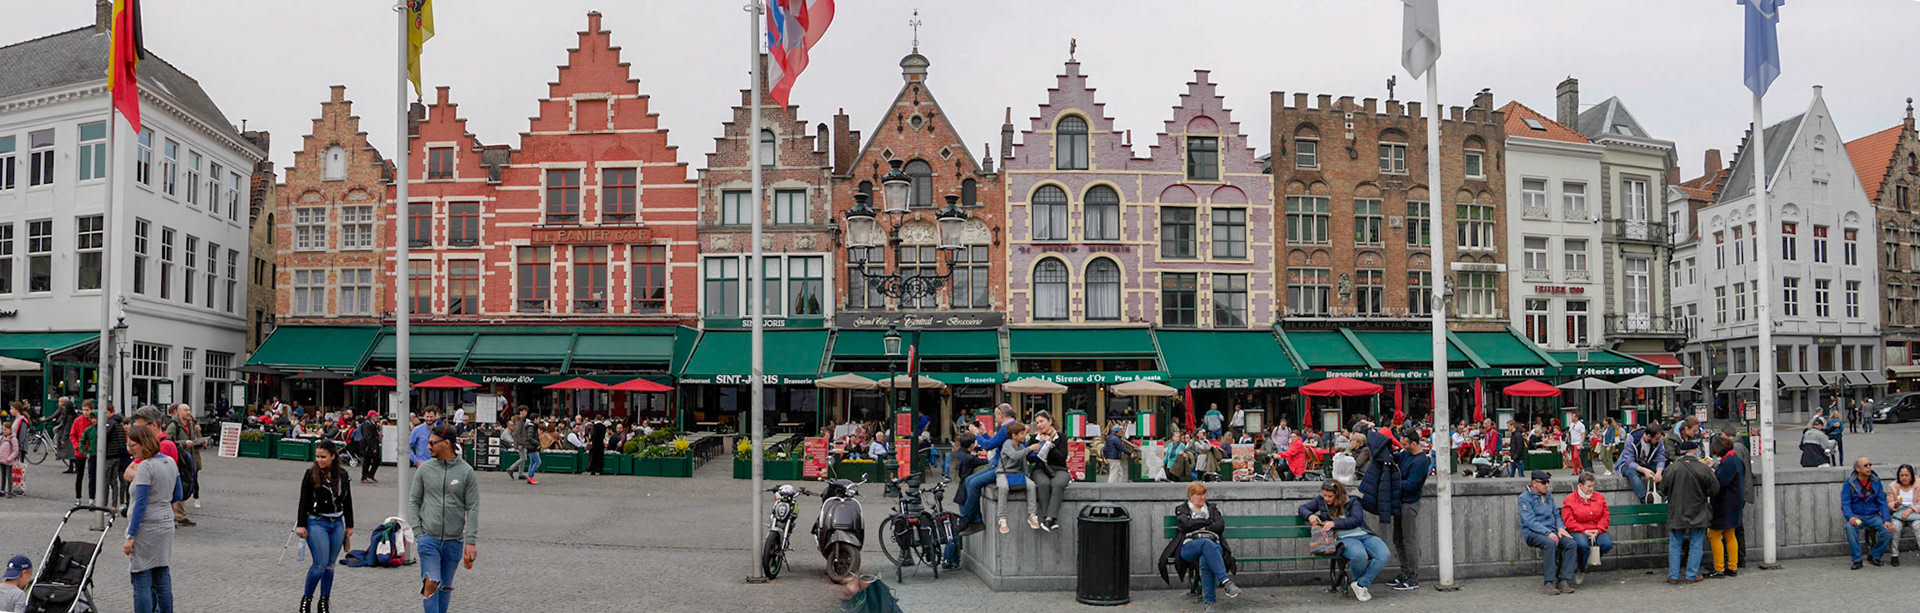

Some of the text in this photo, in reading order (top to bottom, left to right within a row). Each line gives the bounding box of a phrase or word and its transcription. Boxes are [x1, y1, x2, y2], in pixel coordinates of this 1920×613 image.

[536, 232, 554, 242] LE
[558, 229, 610, 242] PANIER
[1502, 368, 1545, 376] PETIT CAFE
[1619, 367, 1645, 375] 1900
[1087, 374, 1106, 382] d'Or
[1189, 378, 1286, 390] CAFE DES ARTS
